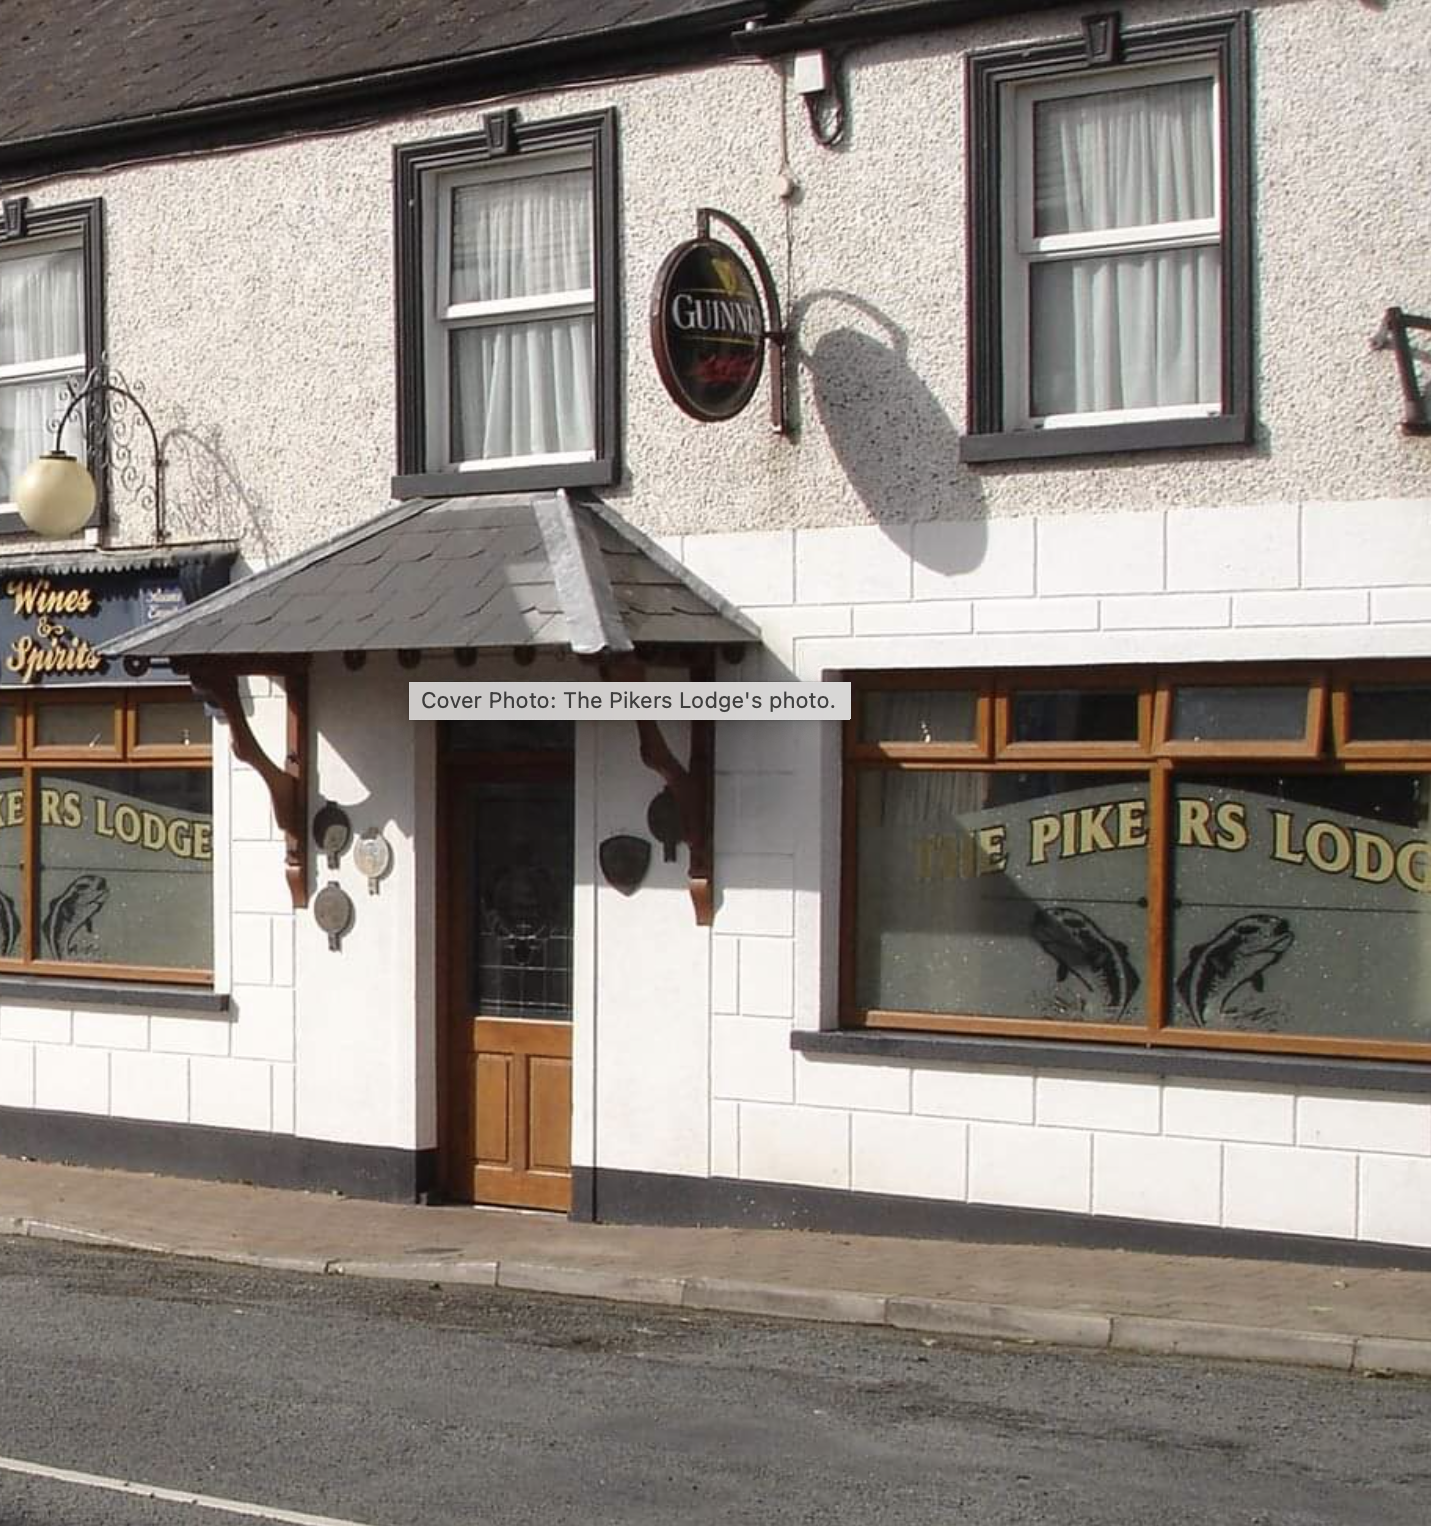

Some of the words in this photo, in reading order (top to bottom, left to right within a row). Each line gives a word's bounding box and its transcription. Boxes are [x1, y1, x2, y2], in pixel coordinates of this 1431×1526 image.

[7, 579, 91, 615] Wines
[37, 616, 64, 637] &
[6, 636, 102, 684] Spirits
[93, 797, 214, 860] LODGE
[1028, 797, 1248, 866] PIKERS
